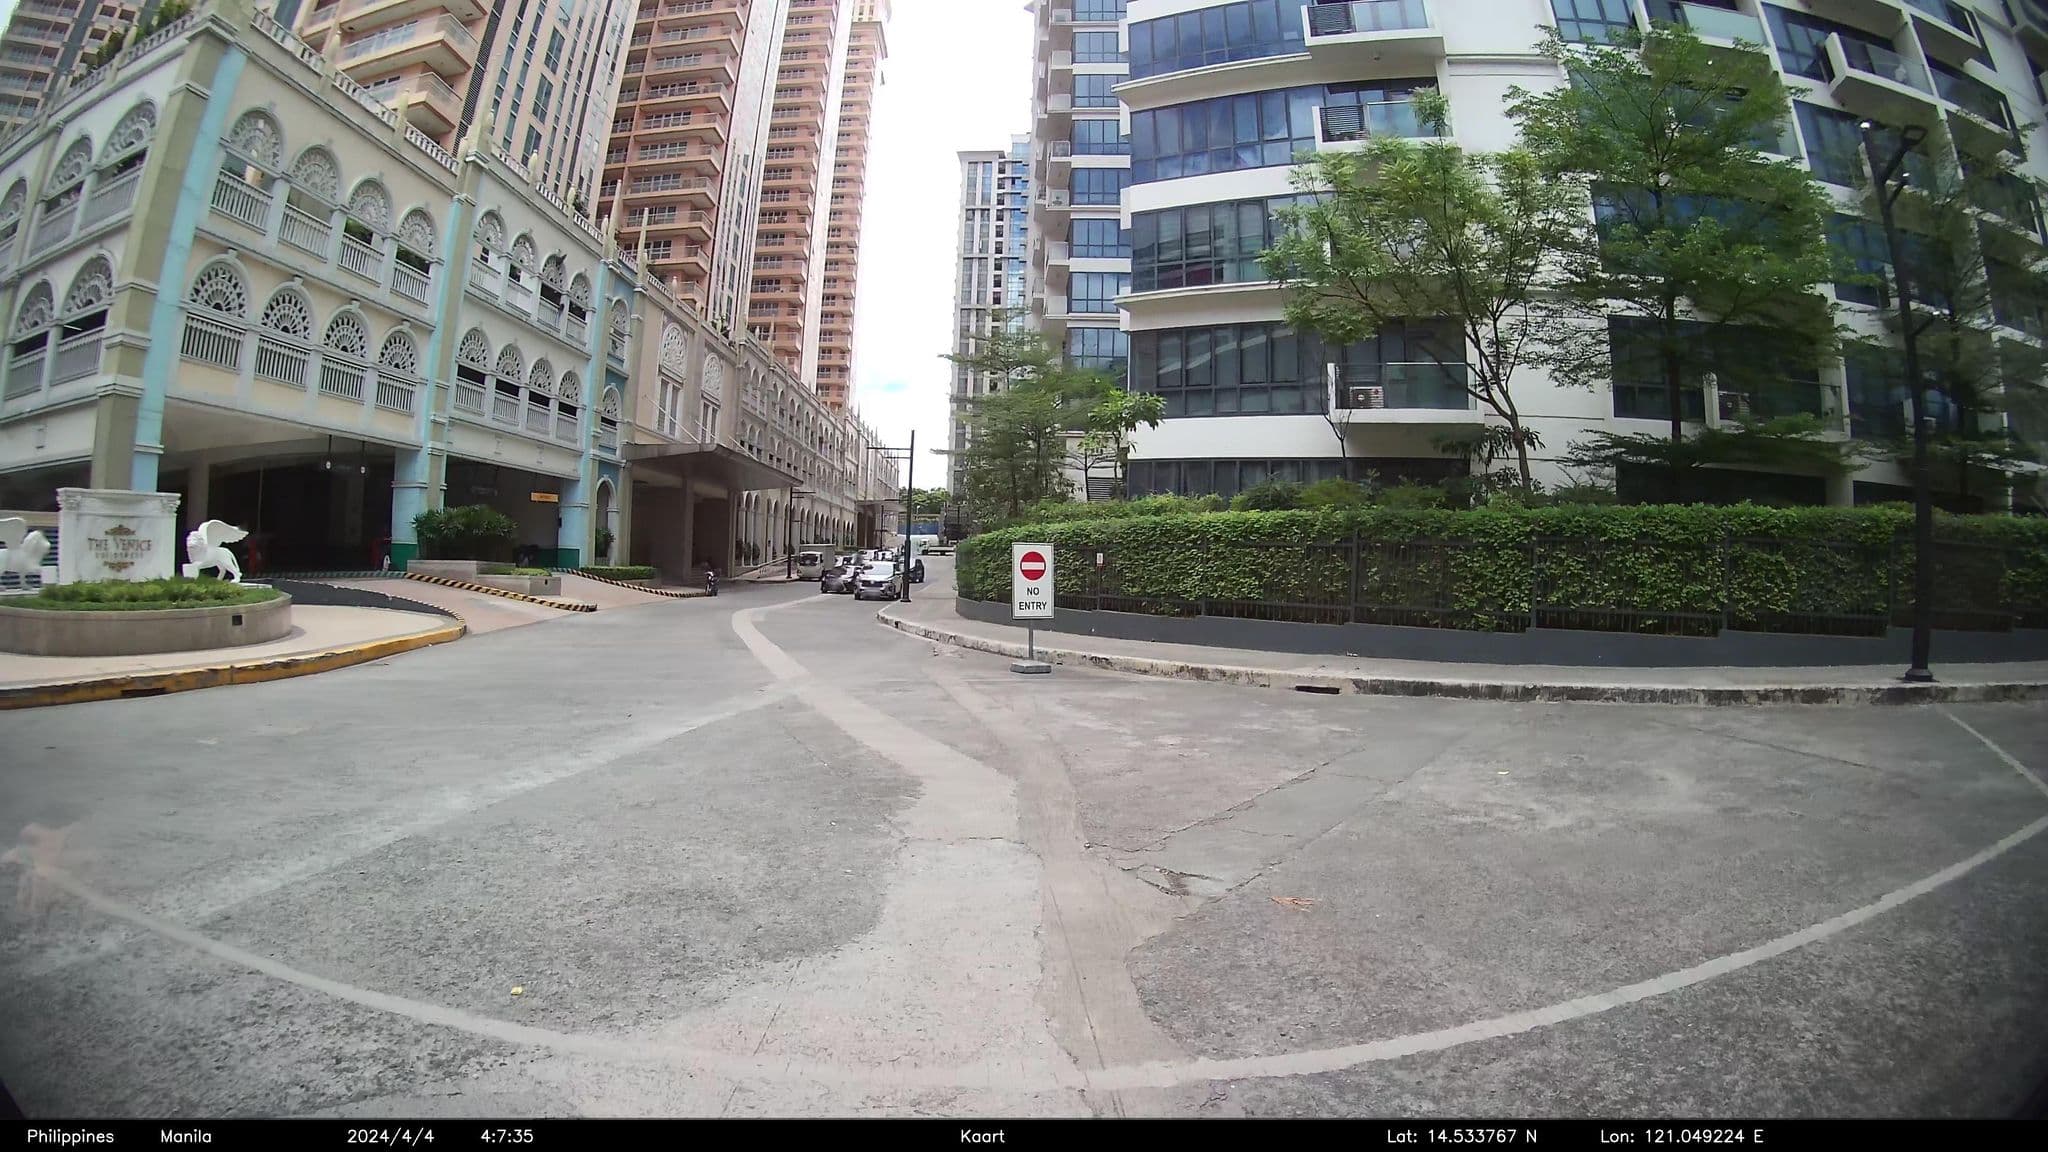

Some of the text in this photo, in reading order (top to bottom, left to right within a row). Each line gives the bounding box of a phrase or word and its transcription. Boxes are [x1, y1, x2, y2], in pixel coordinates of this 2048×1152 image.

[88, 537, 152, 551] THE VENICE
[1027, 587, 1039, 596] NO
[1019, 601, 1047, 611] ENTRY
